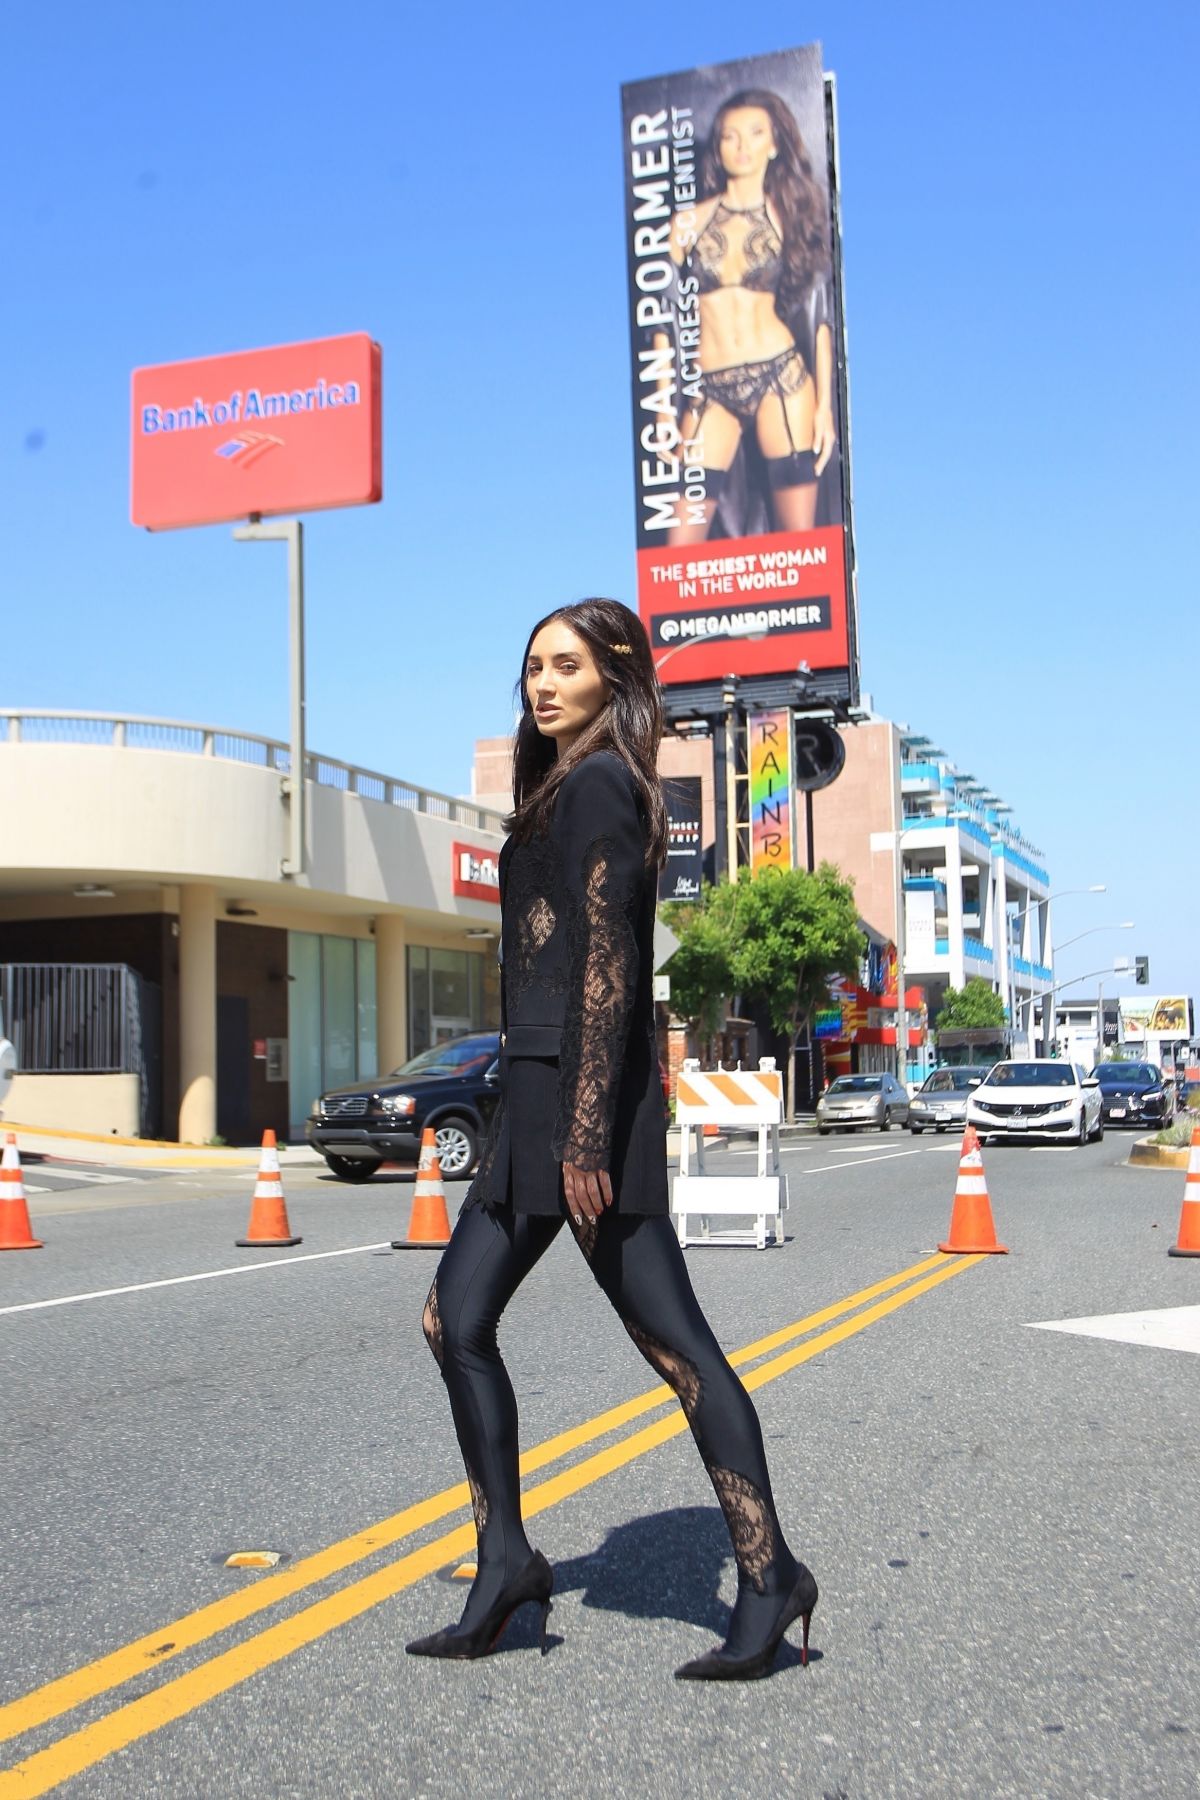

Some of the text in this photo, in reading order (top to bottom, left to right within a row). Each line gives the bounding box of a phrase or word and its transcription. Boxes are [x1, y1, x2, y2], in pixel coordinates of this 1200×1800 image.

[671, 106, 697, 248] SCIENTIST
[631, 109, 682, 531] MEGAN PORMER
[678, 276, 703, 400] ACTRESS
[142, 378, 361, 436] Bank of America
[684, 433, 707, 525] MODEL
[650, 546, 827, 583] THE SEXIEST WOMAN
[678, 568, 800, 598] IN THE WORLD
